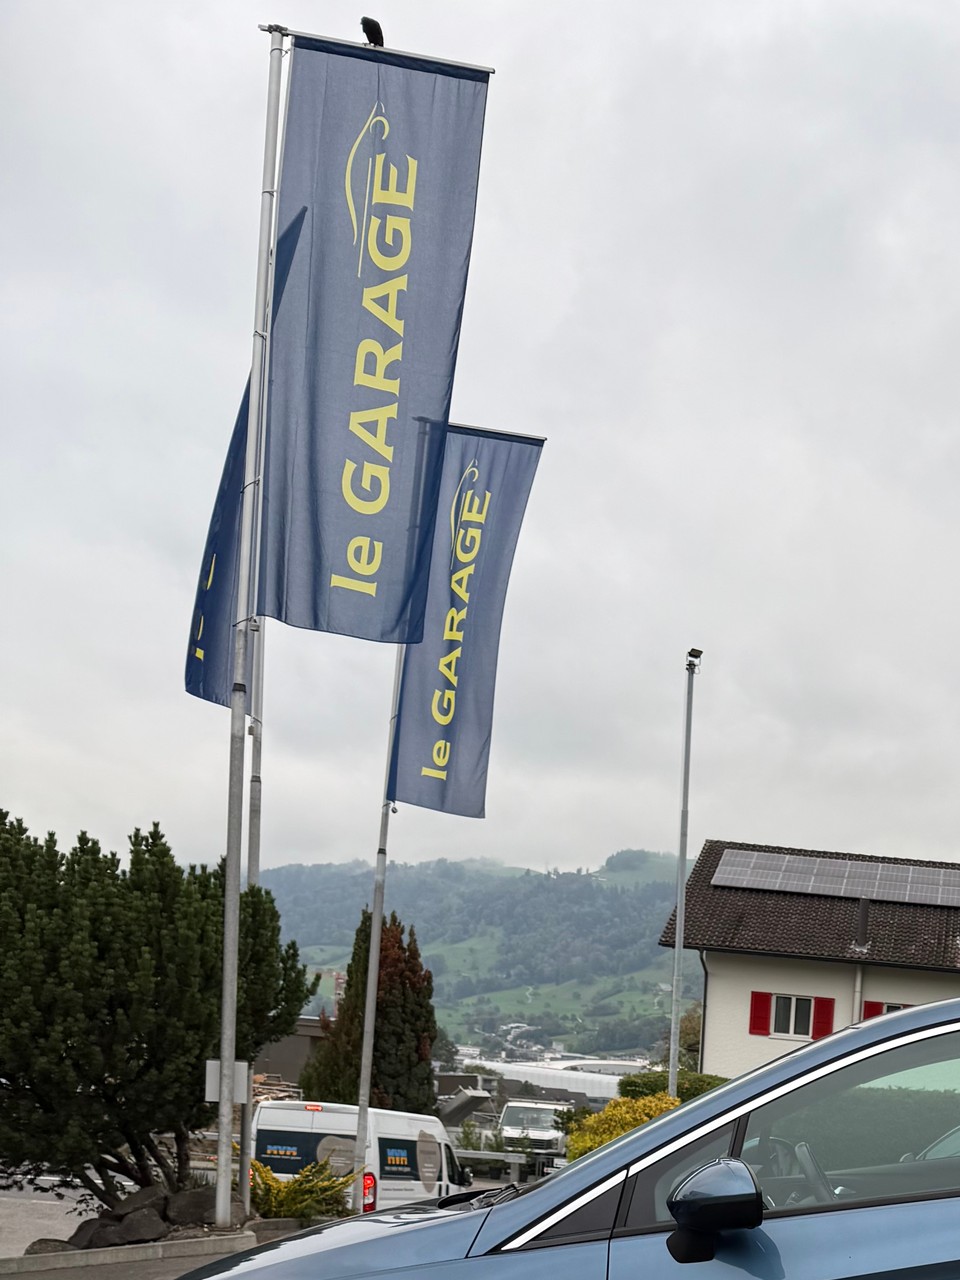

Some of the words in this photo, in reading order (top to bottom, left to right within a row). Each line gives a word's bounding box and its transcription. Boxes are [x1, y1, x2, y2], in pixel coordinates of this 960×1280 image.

[341, 153, 418, 515] GARAGE
[330, 536, 383, 598] le
[431, 489, 492, 726] GARAGE
[421, 739, 451, 781] le
